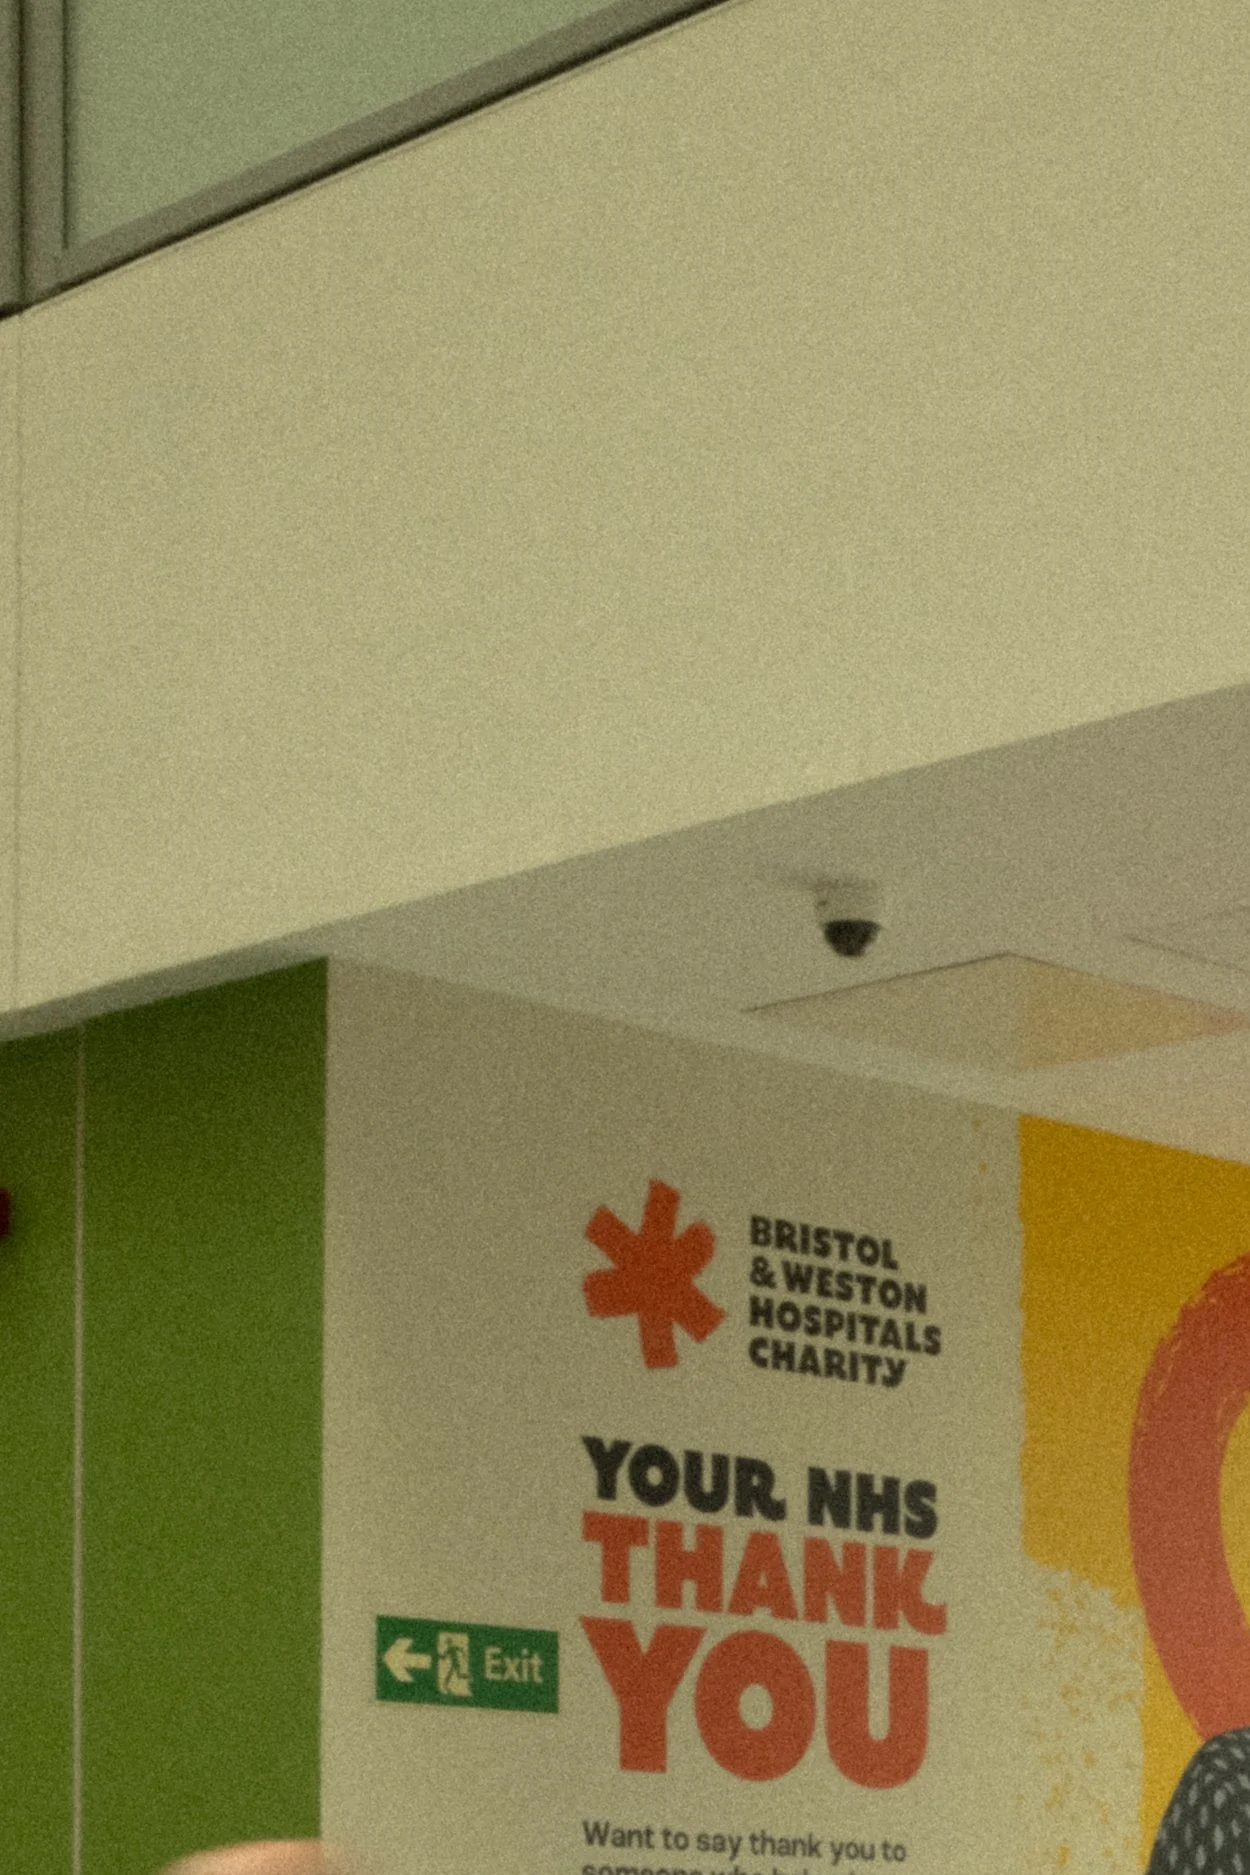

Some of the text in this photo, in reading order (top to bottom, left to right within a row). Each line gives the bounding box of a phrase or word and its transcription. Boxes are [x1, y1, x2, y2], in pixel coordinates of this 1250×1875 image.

[748, 1214, 899, 1270] BRISTOL
[749, 1255, 928, 1315] & WESTON
[748, 1295, 942, 1356] HOSPITALS
[748, 1337, 907, 1388] CHARITY
[582, 1435, 938, 1539] YOUR NHS
[583, 1511, 947, 1636] THANK
[484, 1646, 544, 1683] Exit
[580, 1616, 929, 1789] YOU
[583, 1821, 907, 1866] Want to say thank you to
